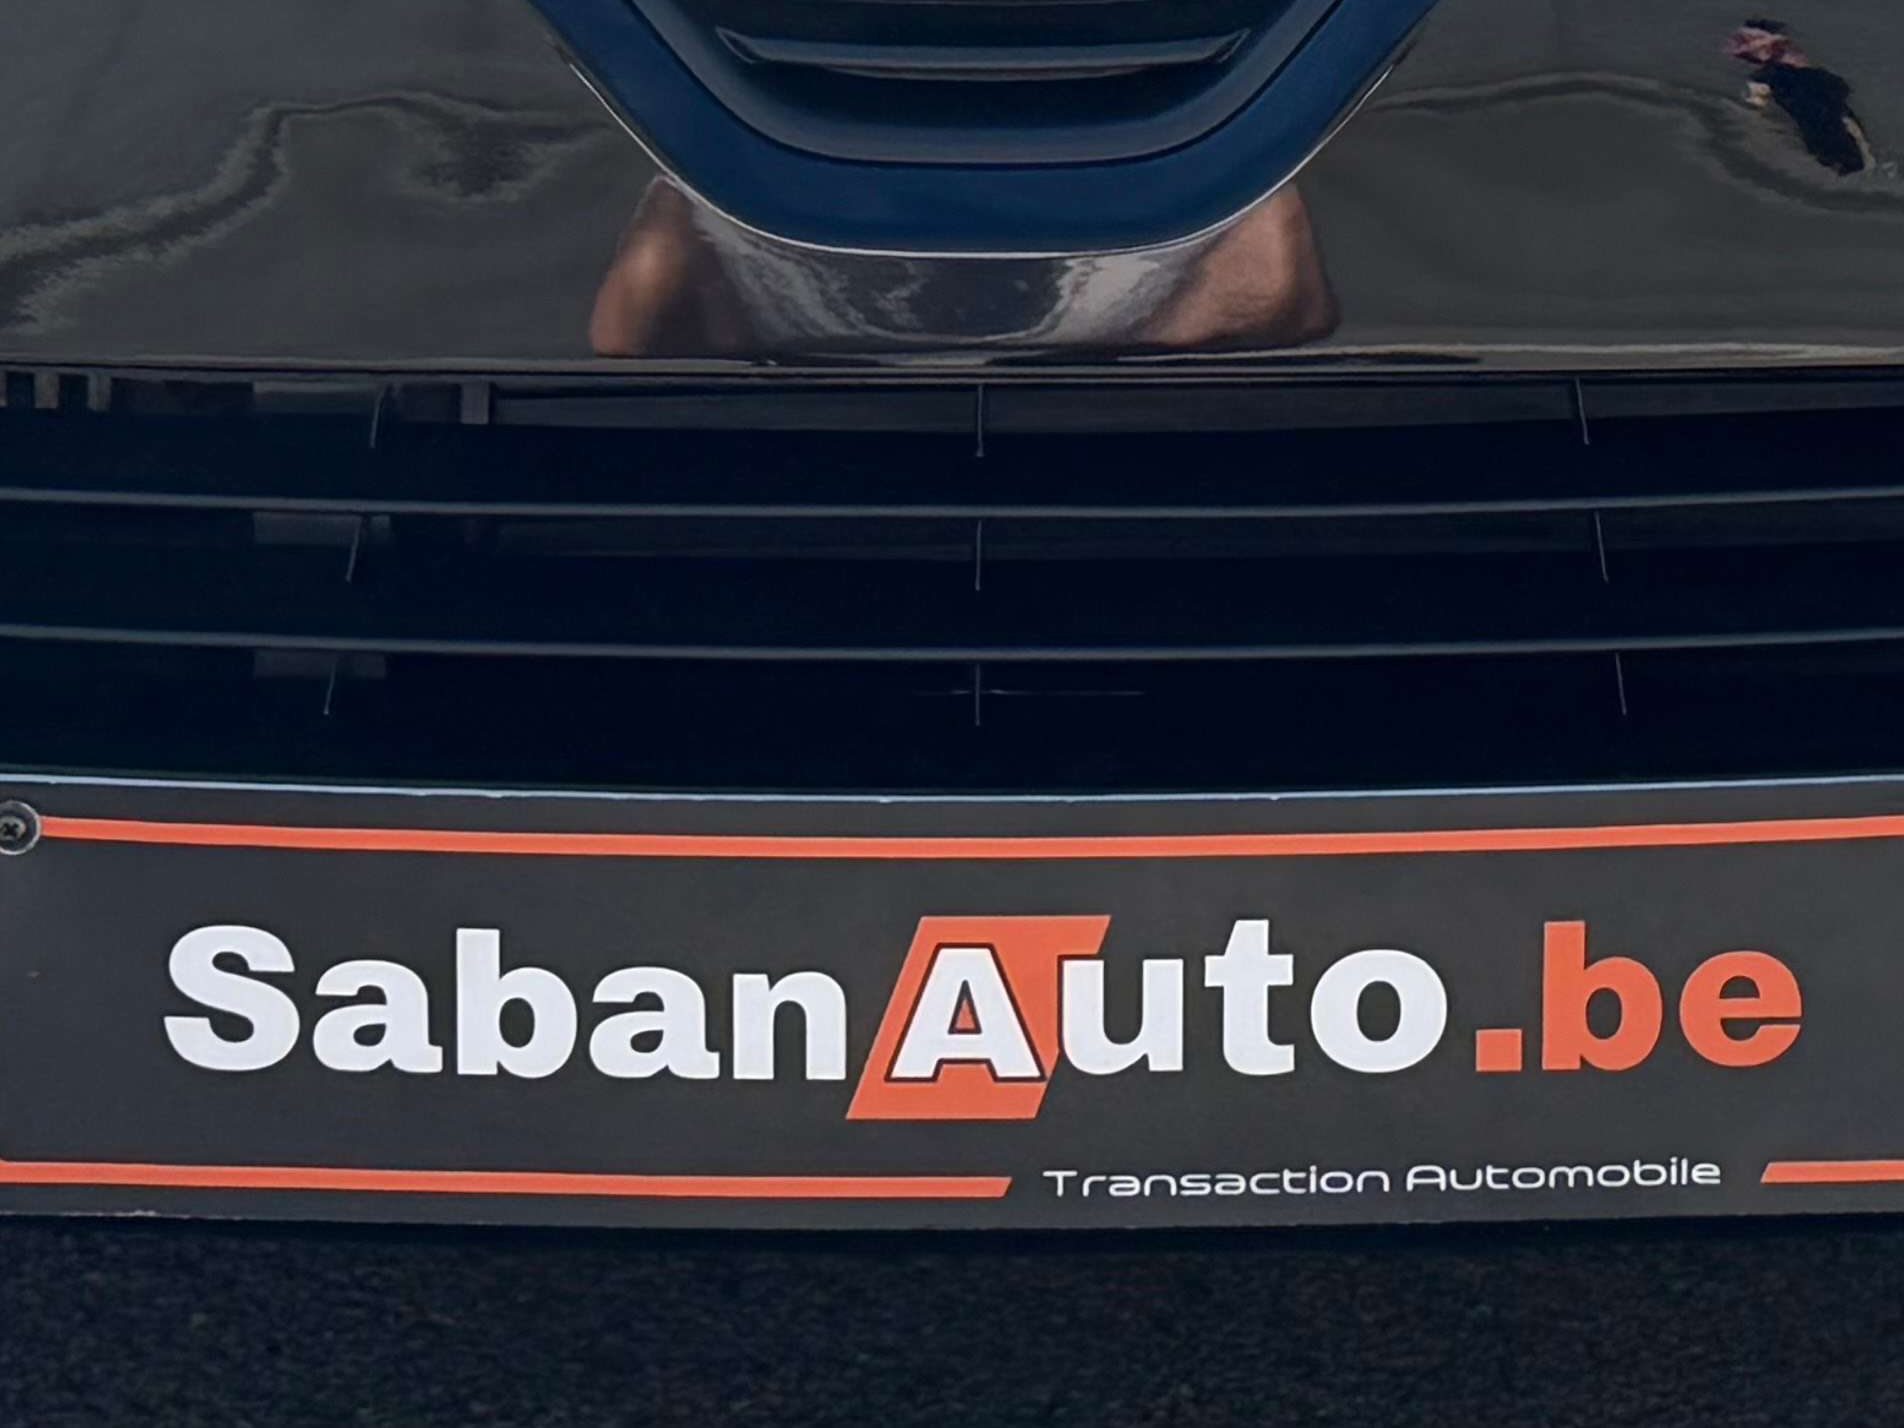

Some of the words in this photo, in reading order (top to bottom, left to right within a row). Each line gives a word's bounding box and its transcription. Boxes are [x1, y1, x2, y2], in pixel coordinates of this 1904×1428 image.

[162, 917, 1803, 1082] SabanAuto.be
[1040, 1164, 1392, 1199] Transaction
[1404, 1155, 1723, 1194] Automobile
